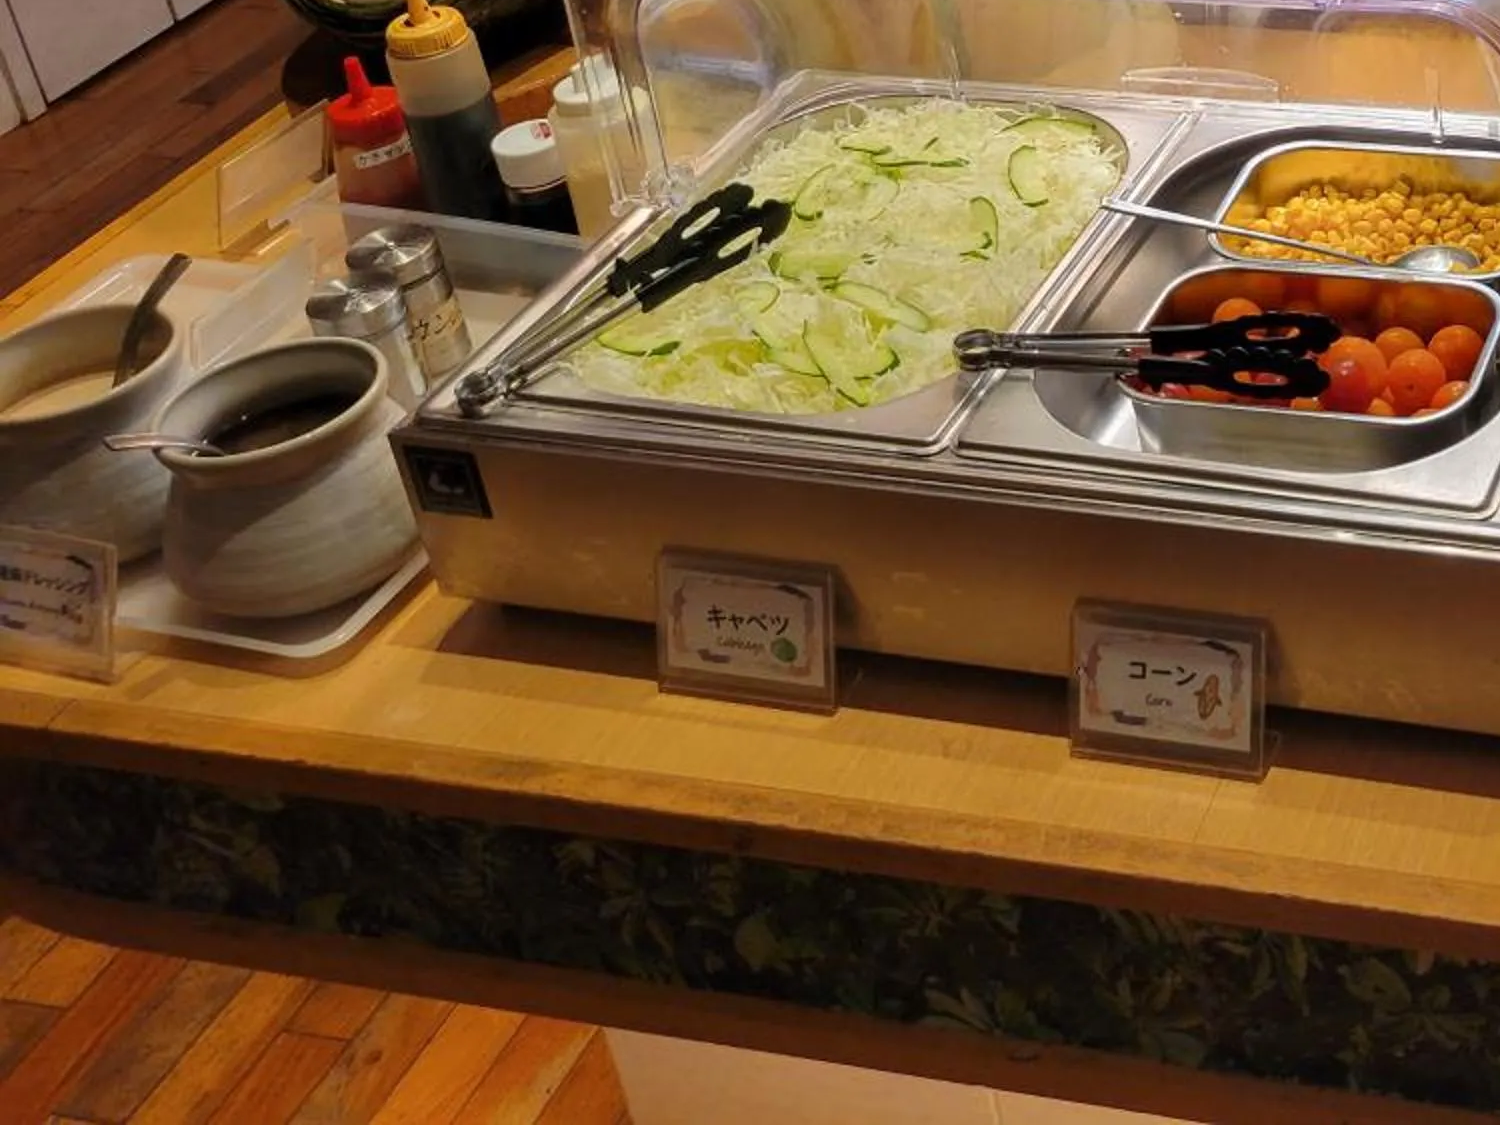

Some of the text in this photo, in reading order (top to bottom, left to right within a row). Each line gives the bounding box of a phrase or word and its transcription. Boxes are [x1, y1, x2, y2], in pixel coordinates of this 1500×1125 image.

[706, 604, 790, 635] キャベツ
[1128, 661, 1198, 686] コーン
[1145, 693, 1173, 707] Corn
